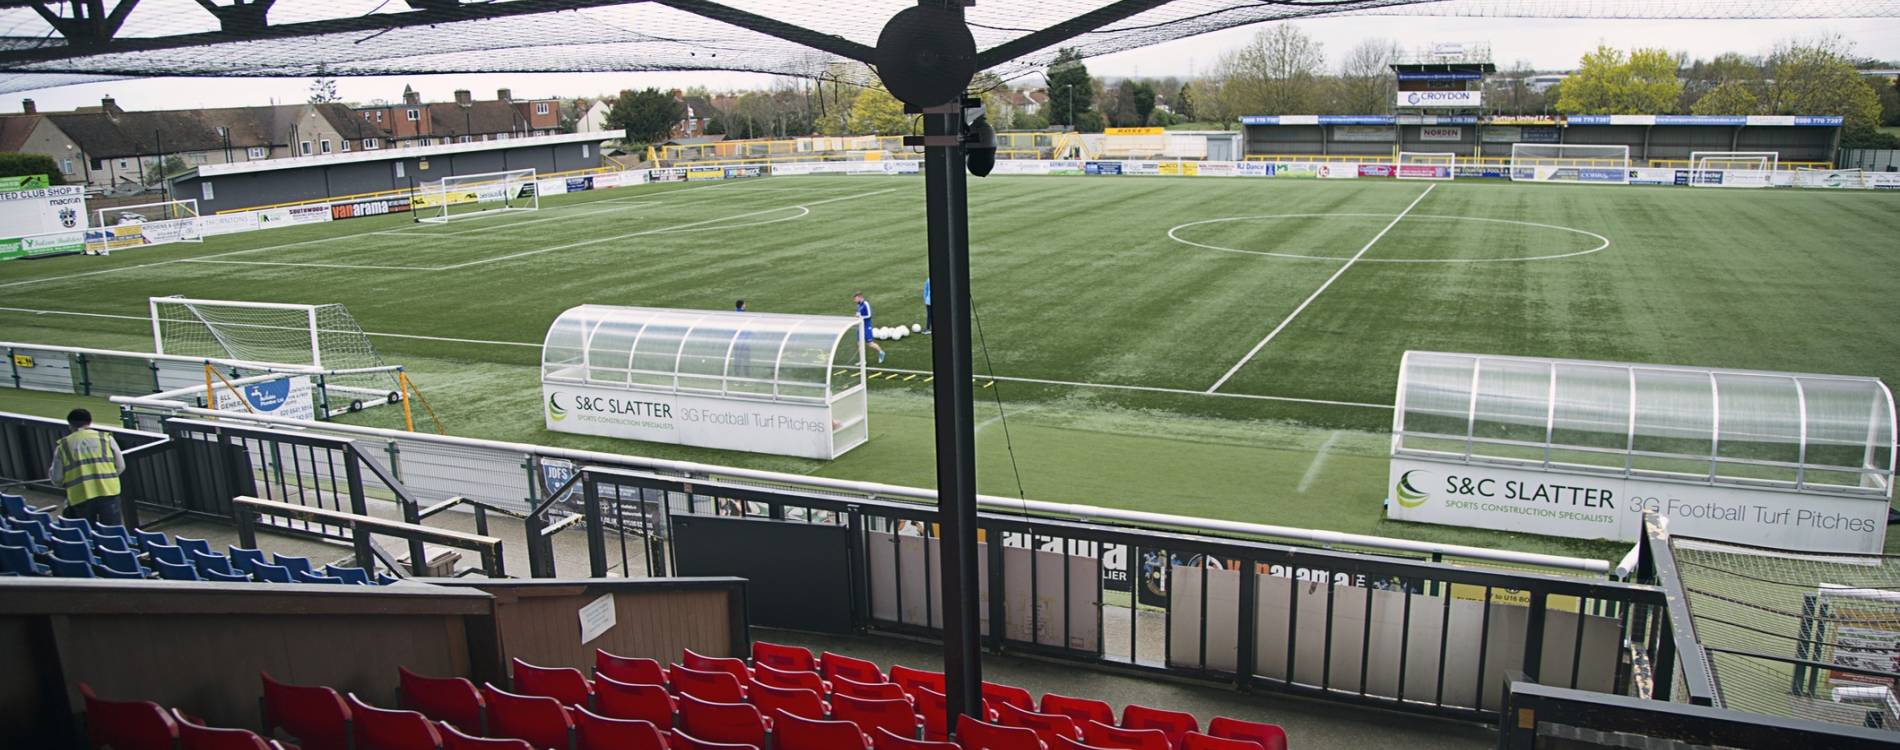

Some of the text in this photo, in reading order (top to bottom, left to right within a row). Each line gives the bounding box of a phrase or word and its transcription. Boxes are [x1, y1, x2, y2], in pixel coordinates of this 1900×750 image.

[1421, 92, 1470, 100] CROYDON
[1424, 128, 1458, 136] NORDEN
[20, 190, 45, 199] CLUB
[47, 188, 72, 196] SHOP
[49, 197, 81, 206] macron
[289, 206, 322, 215] SOUTHWOOD
[332, 201, 388, 219] vanarama
[576, 396, 672, 419] S&C SLATTER
[577, 414, 674, 430] SPORTS CONSTRUCTION SPECIALISTS
[681, 407, 824, 433] 3G Football Turf Pitches
[1446, 475, 1614, 509] S&C SLATTER
[1445, 500, 1614, 523] SPORTS CONSTRUCTION SPECIALISTS
[1629, 496, 1876, 533] 3G Football Turf Pitches
